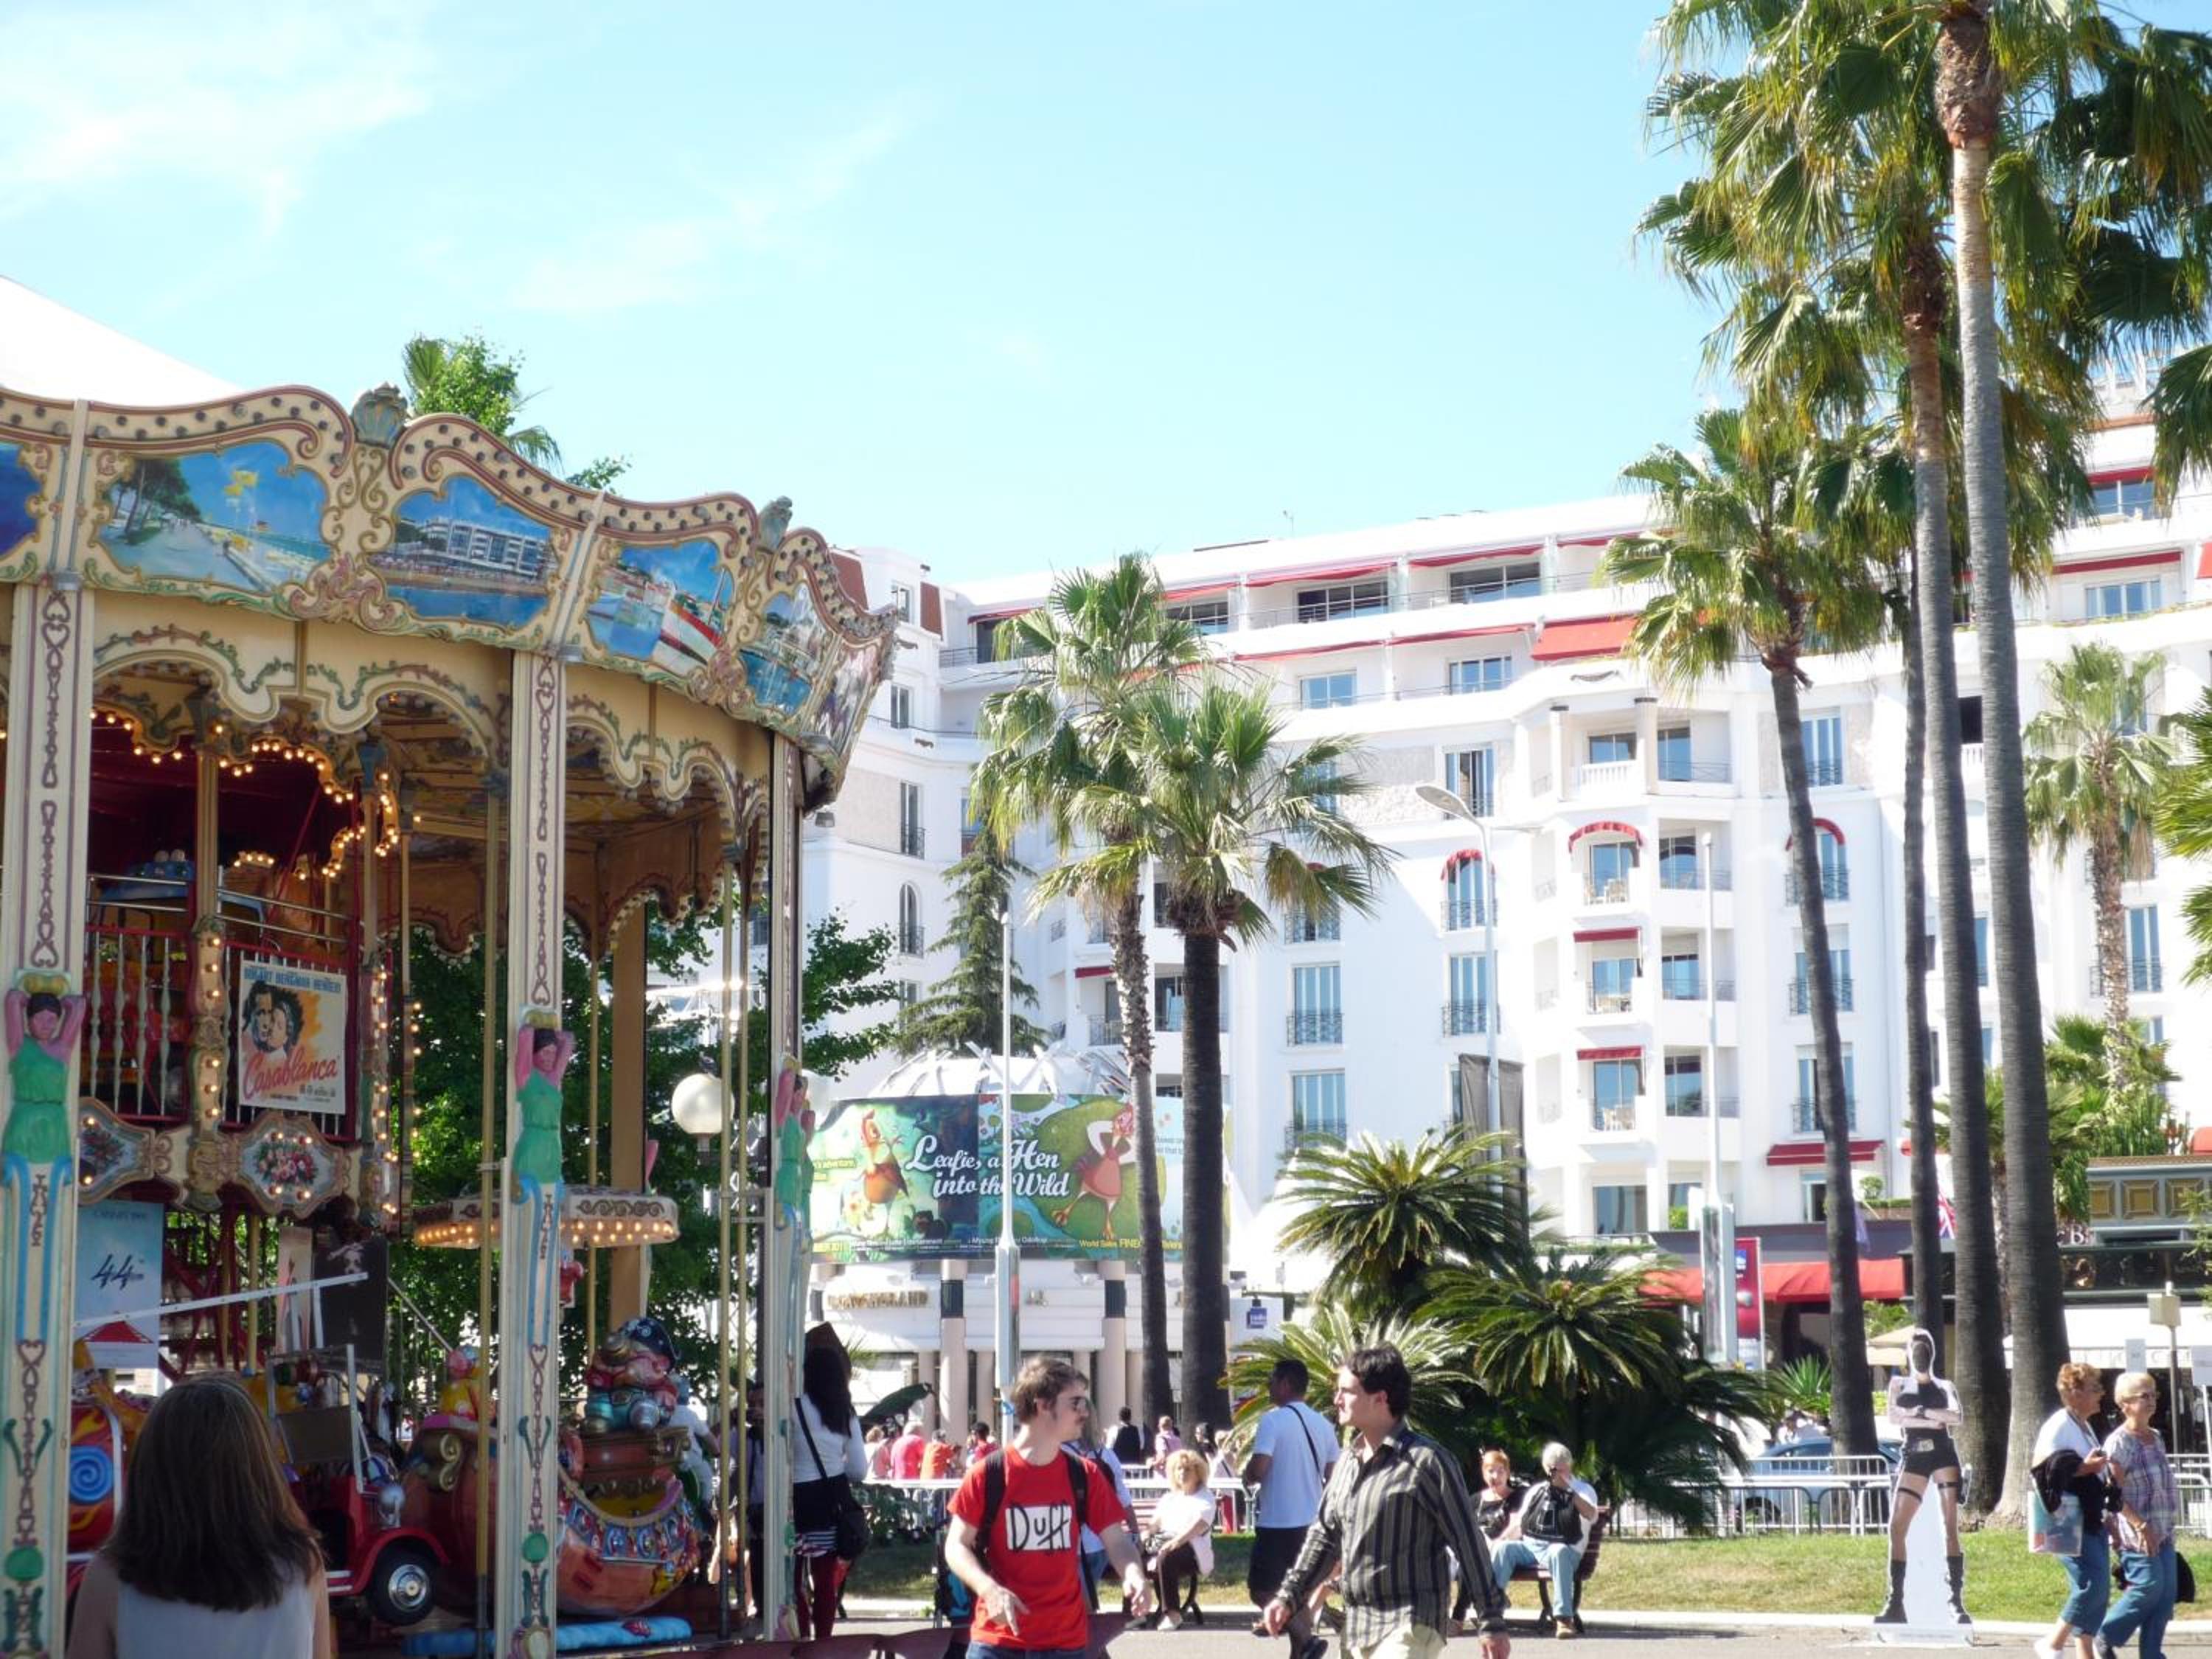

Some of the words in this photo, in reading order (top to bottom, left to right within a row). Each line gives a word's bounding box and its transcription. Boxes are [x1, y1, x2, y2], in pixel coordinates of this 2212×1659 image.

[243, 1046, 338, 1099] Casablanca
[905, 1135, 982, 1178] Leafie,
[987, 1157, 1001, 1168] a
[1011, 1139, 1060, 1171] Hen
[933, 1172, 978, 1198] into
[979, 1175, 1004, 1195] th
[1012, 1172, 1070, 1197] Wild
[90, 1253, 133, 1291] 44
[1010, 1502, 1070, 1554] Duff
